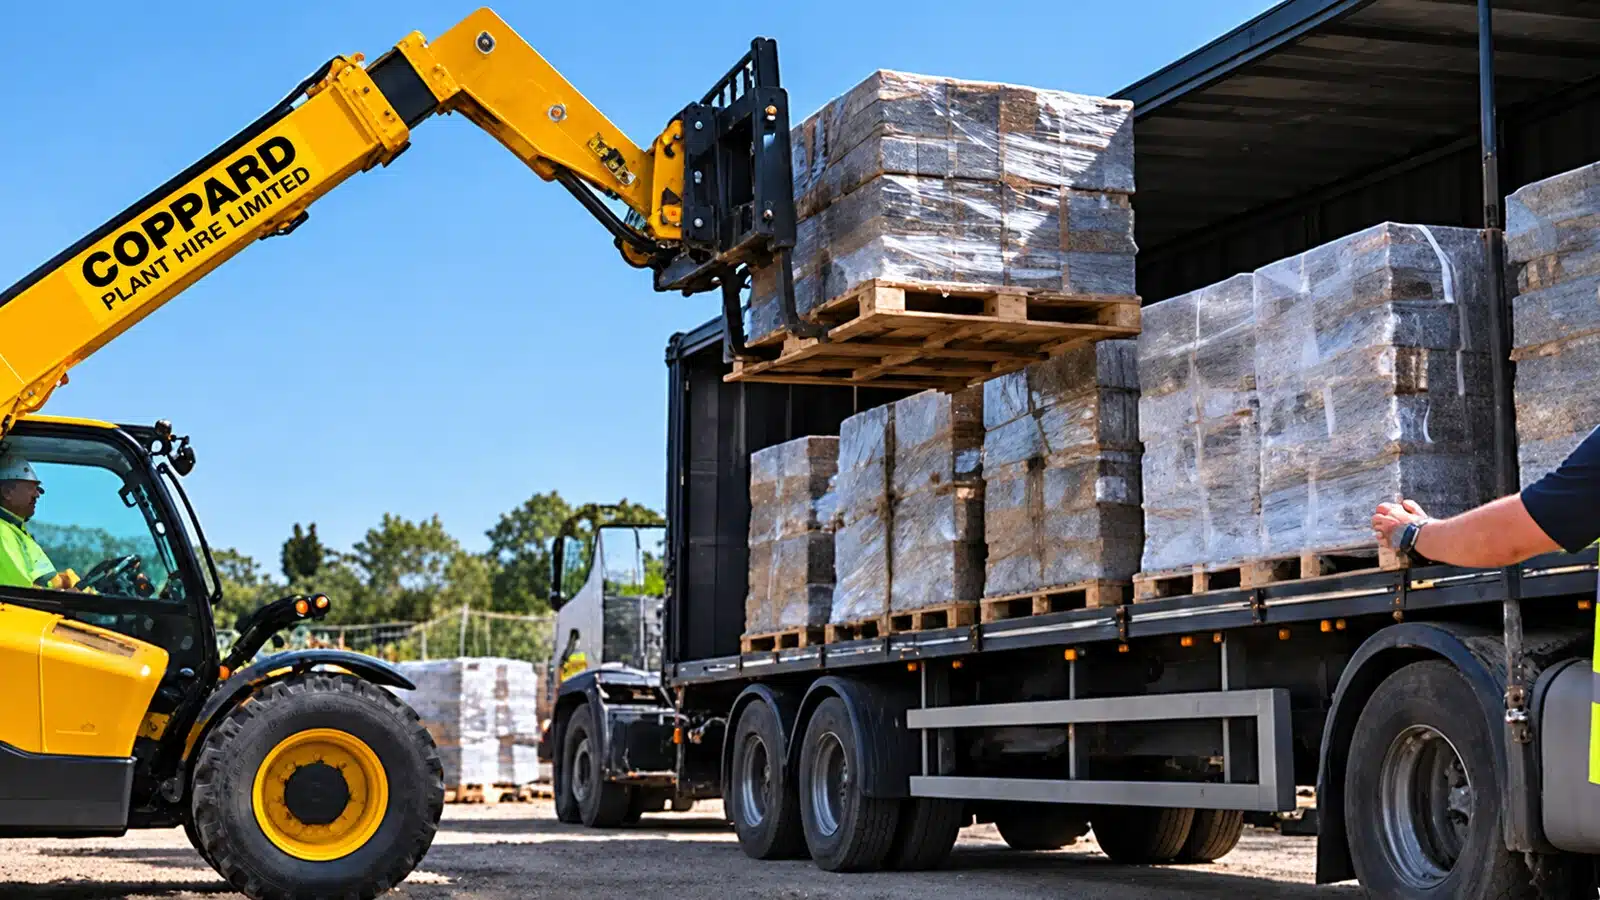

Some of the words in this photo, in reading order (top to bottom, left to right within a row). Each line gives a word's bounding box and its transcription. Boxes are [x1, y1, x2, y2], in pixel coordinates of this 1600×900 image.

[82, 136, 296, 288] COPPARD
[101, 256, 170, 311] PLANT
[173, 221, 227, 263] HIRE
[226, 167, 310, 228] LIMITED
